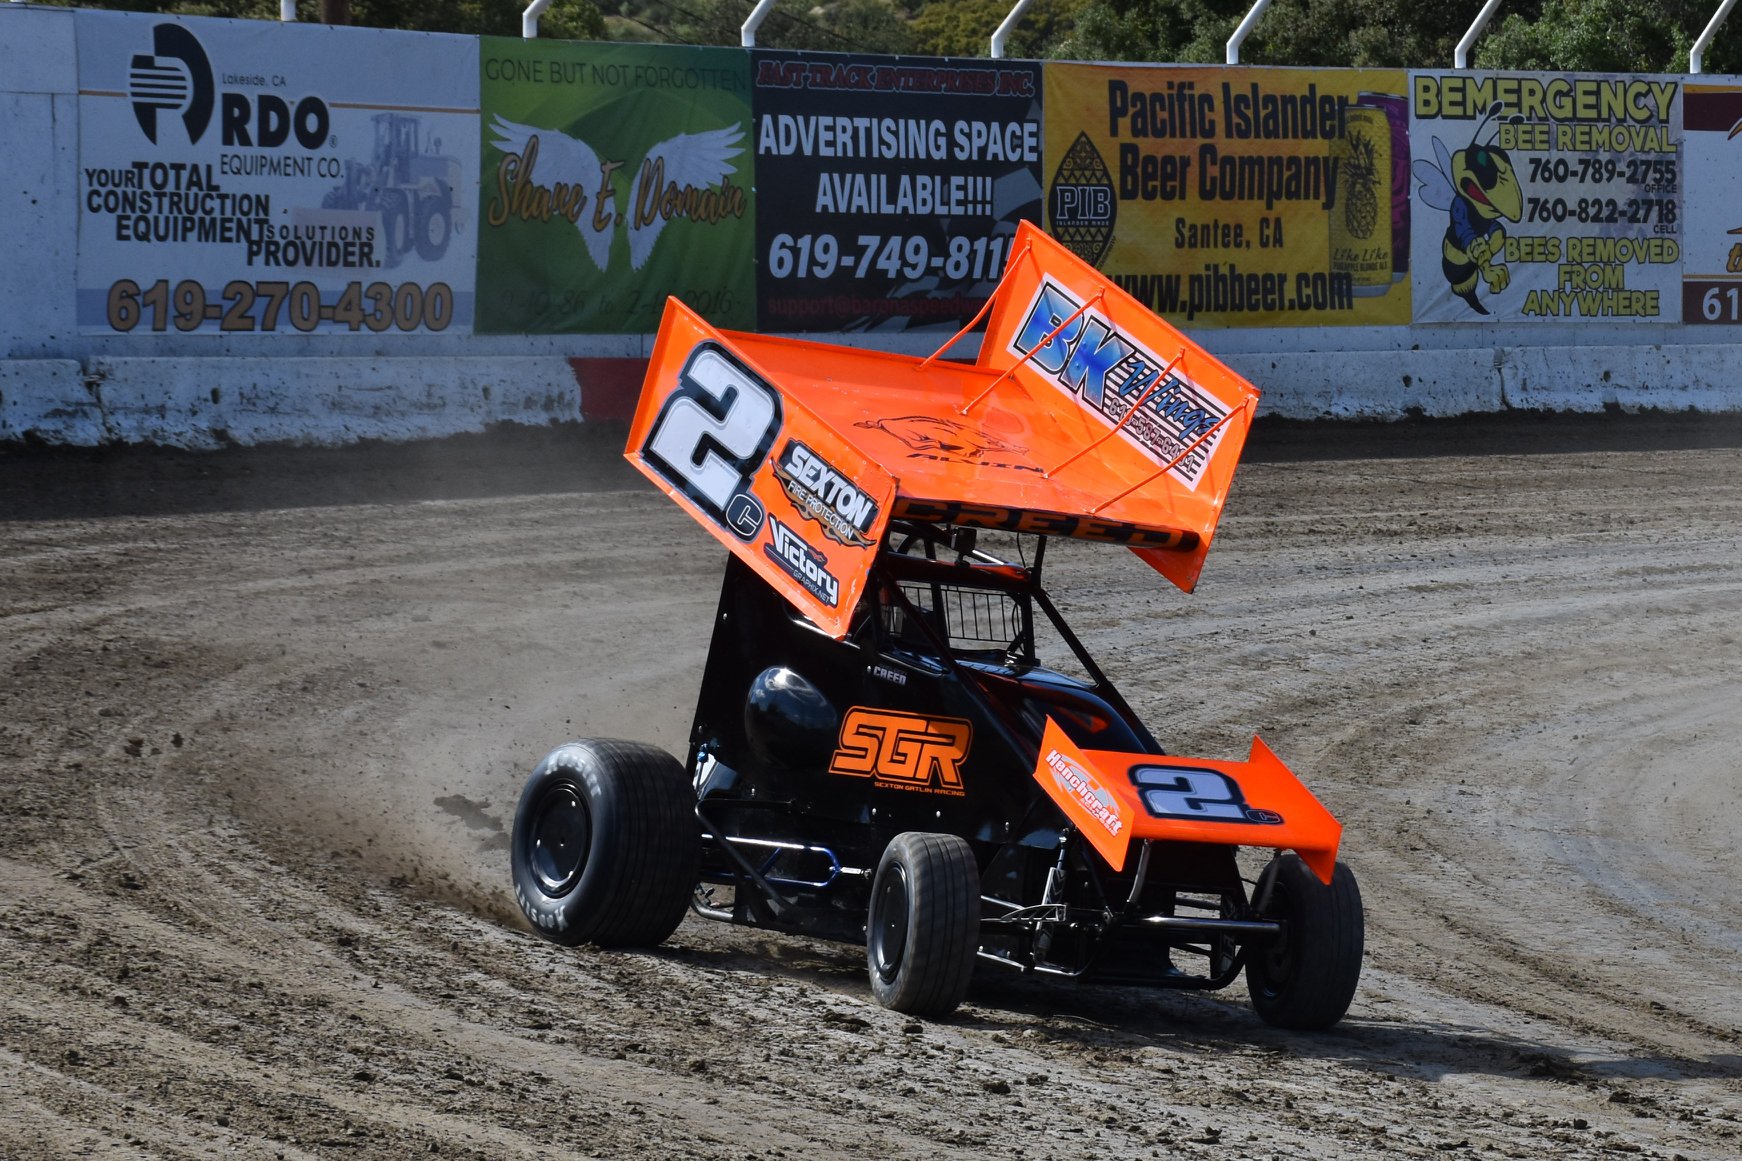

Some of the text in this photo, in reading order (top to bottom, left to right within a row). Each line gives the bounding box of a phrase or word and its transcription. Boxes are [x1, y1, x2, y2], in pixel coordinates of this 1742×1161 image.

[271, 75, 287, 88] CA
[485, 58, 746, 91] GONE BUT NOT FORGOTTEN
[757, 61, 804, 88] FAST
[807, 63, 874, 91] TRACK
[875, 66, 997, 95] ENTERPRISES
[1107, 79, 1349, 140] Pacific Islander
[1414, 75, 1679, 123] BEMERGENCY
[221, 92, 330, 150] RDO
[1499, 122, 1677, 153] BEE REMOVAL
[758, 114, 1038, 162] ADVERTISING SPACE
[85, 161, 220, 192] YOUR TOTAL
[220, 153, 345, 179] EQUIPMENT CO.
[1118, 142, 1339, 211] Beer Company
[1528, 157, 1677, 185] 760-789-2755
[86, 189, 270, 217] CONSTRUCTION
[815, 172, 993, 216] AVAILABLE!!!
[1056, 185, 1112, 220] PIB
[1644, 184, 1677, 194] OFFICE
[1527, 197, 1677, 224] 760-822-2718
[116, 214, 375, 244] EQUIPMENT SOLUTIONS
[1174, 216, 1284, 250] Santee, CA
[1653, 225, 1677, 234] CELL
[247, 239, 381, 268] PROVIDER.
[1503, 236, 1680, 264] BEES REMOVED
[1557, 264, 1624, 290] FROM
[107, 279, 453, 332] 619-270-4300
[1521, 289, 1660, 317] ANYWHERE
[1012, 281, 1222, 441] BK Wings
[645, 344, 780, 518] 2
[782, 444, 872, 529] SEXTON
[769, 516, 838, 605] Victory
[874, 781, 904, 790] SEXTON
[905, 785, 933, 793] GATLIN
[1133, 765, 1246, 821] 2
